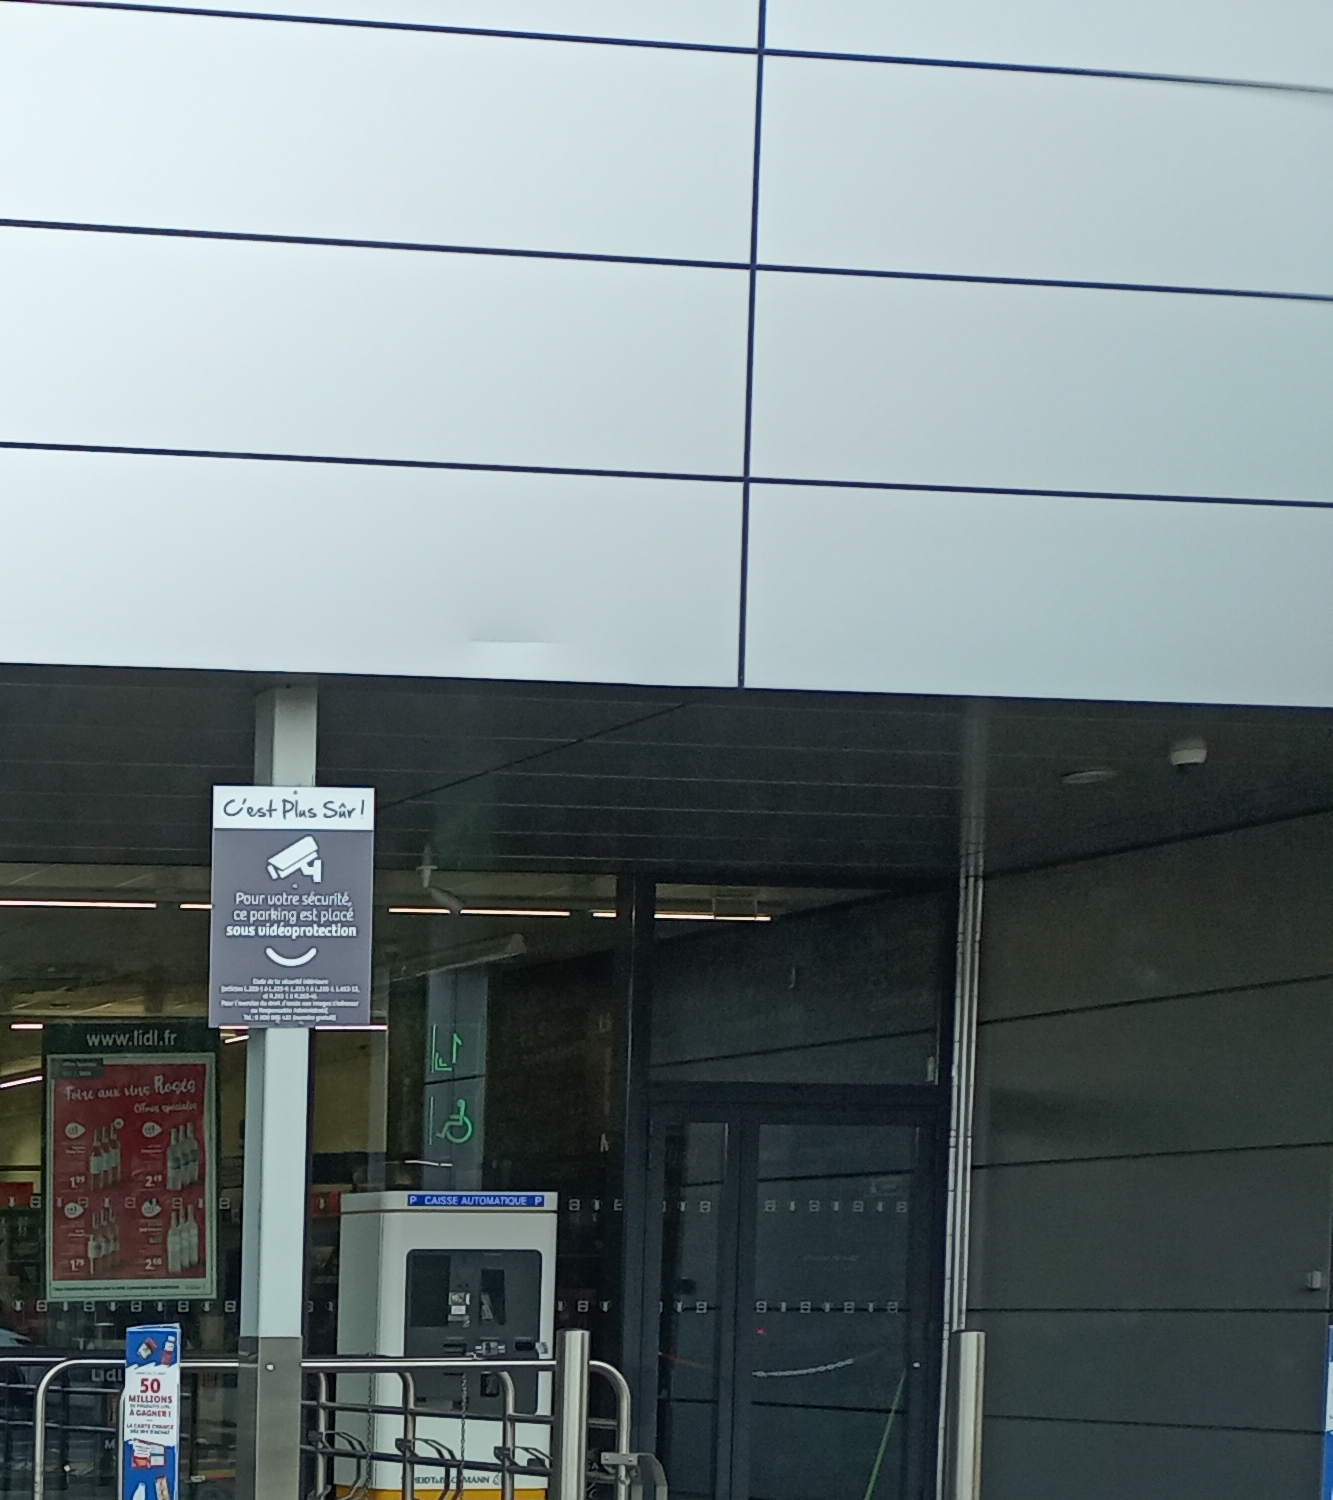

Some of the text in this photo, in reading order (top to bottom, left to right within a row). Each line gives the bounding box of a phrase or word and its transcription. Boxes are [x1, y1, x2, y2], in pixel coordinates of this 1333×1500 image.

[223, 798, 365, 820] C'est Plus Sûr !
[235, 891, 352, 907] Pour votre sécurité,
[233, 908, 354, 924] ce parking est placé
[226, 923, 357, 940] sous vidéoprotection
[86, 1029, 177, 1046] www.lidl.fr
[424, 1196, 458, 1205] CAISSE
[461, 1196, 527, 1205] AUTOMATIQUE
[91, 1368, 122, 1382] Lidl
[140, 1378, 161, 1394] 50
[129, 1395, 173, 1404] MILLIONS
